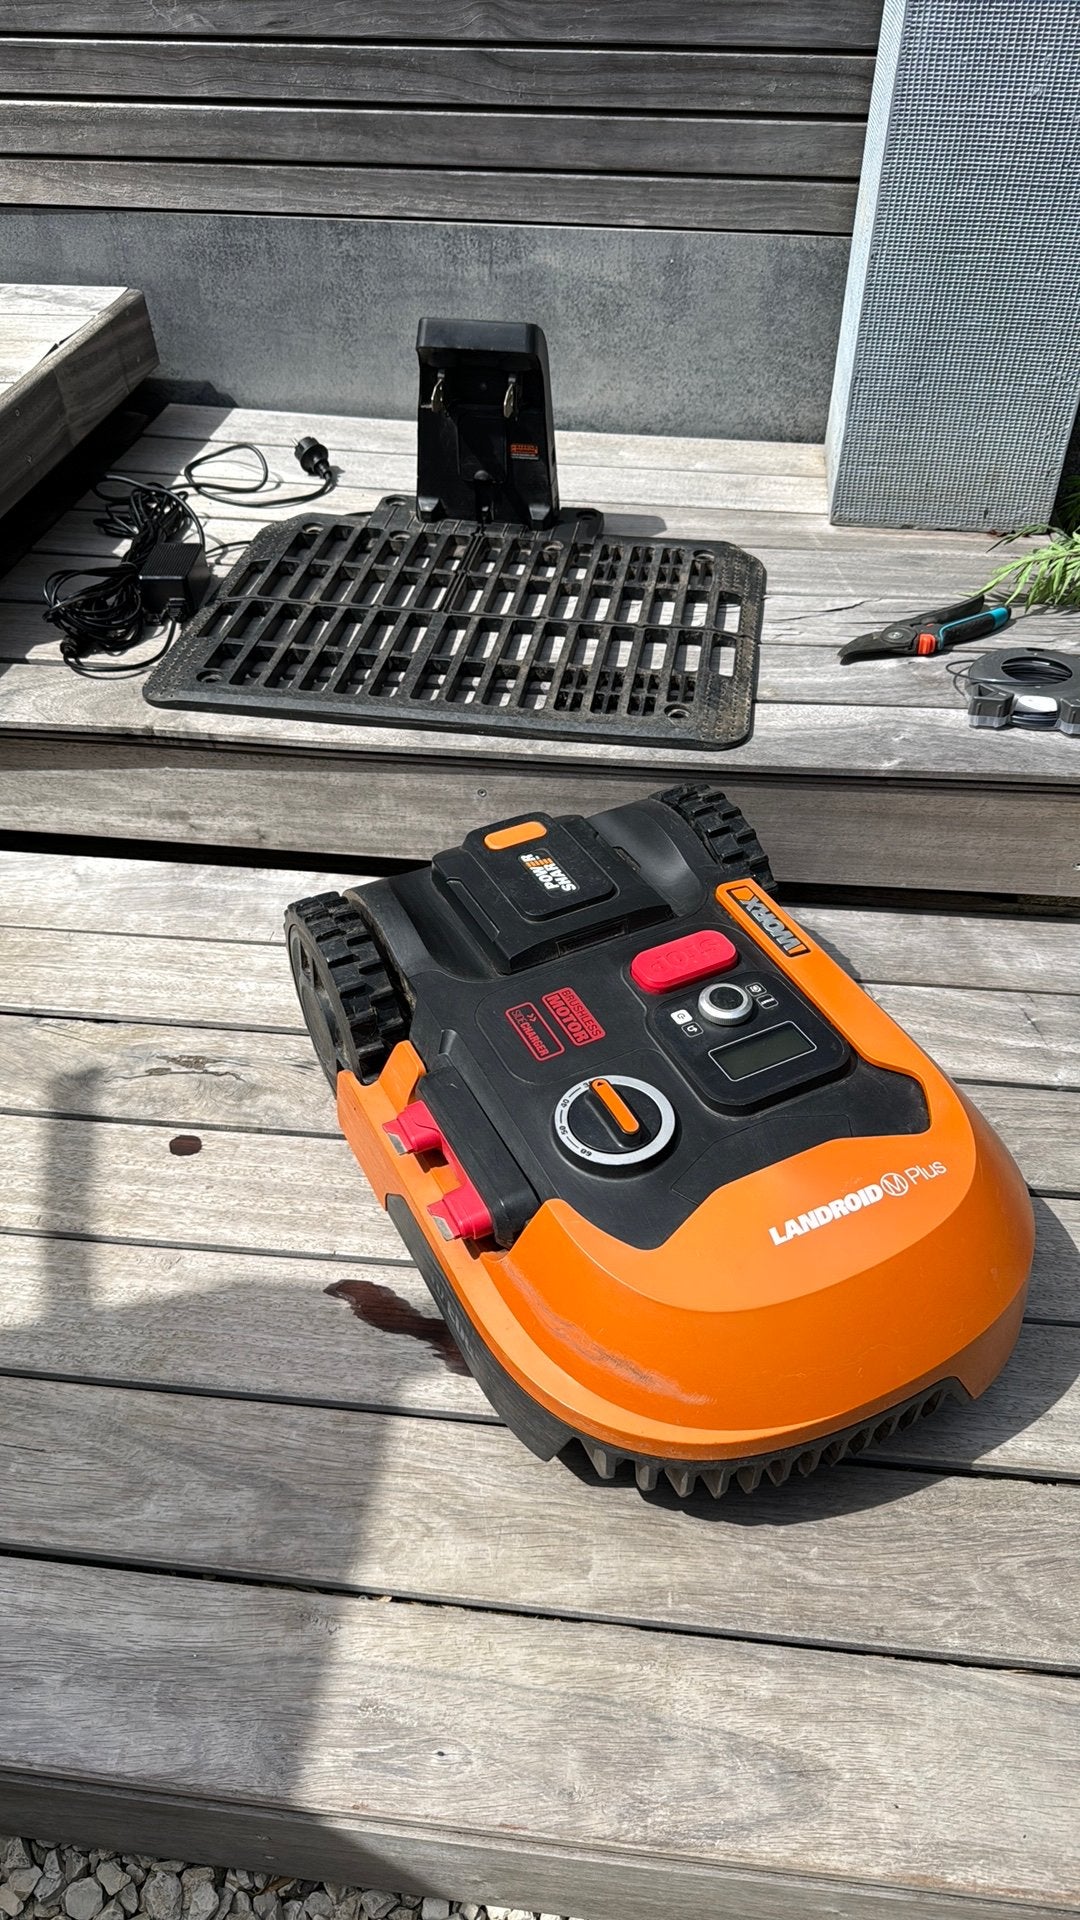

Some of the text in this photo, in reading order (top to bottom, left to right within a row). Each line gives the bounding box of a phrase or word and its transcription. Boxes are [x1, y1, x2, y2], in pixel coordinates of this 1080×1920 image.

[543, 857, 577, 892] SHARE
[739, 895, 801, 951] WORX
[545, 993, 590, 1043] MOTOR
[561, 989, 602, 1037] BRUSHLESS
[580, 1148, 592, 1157] 60
[768, 1161, 947, 1246] LANDROID M Plus
